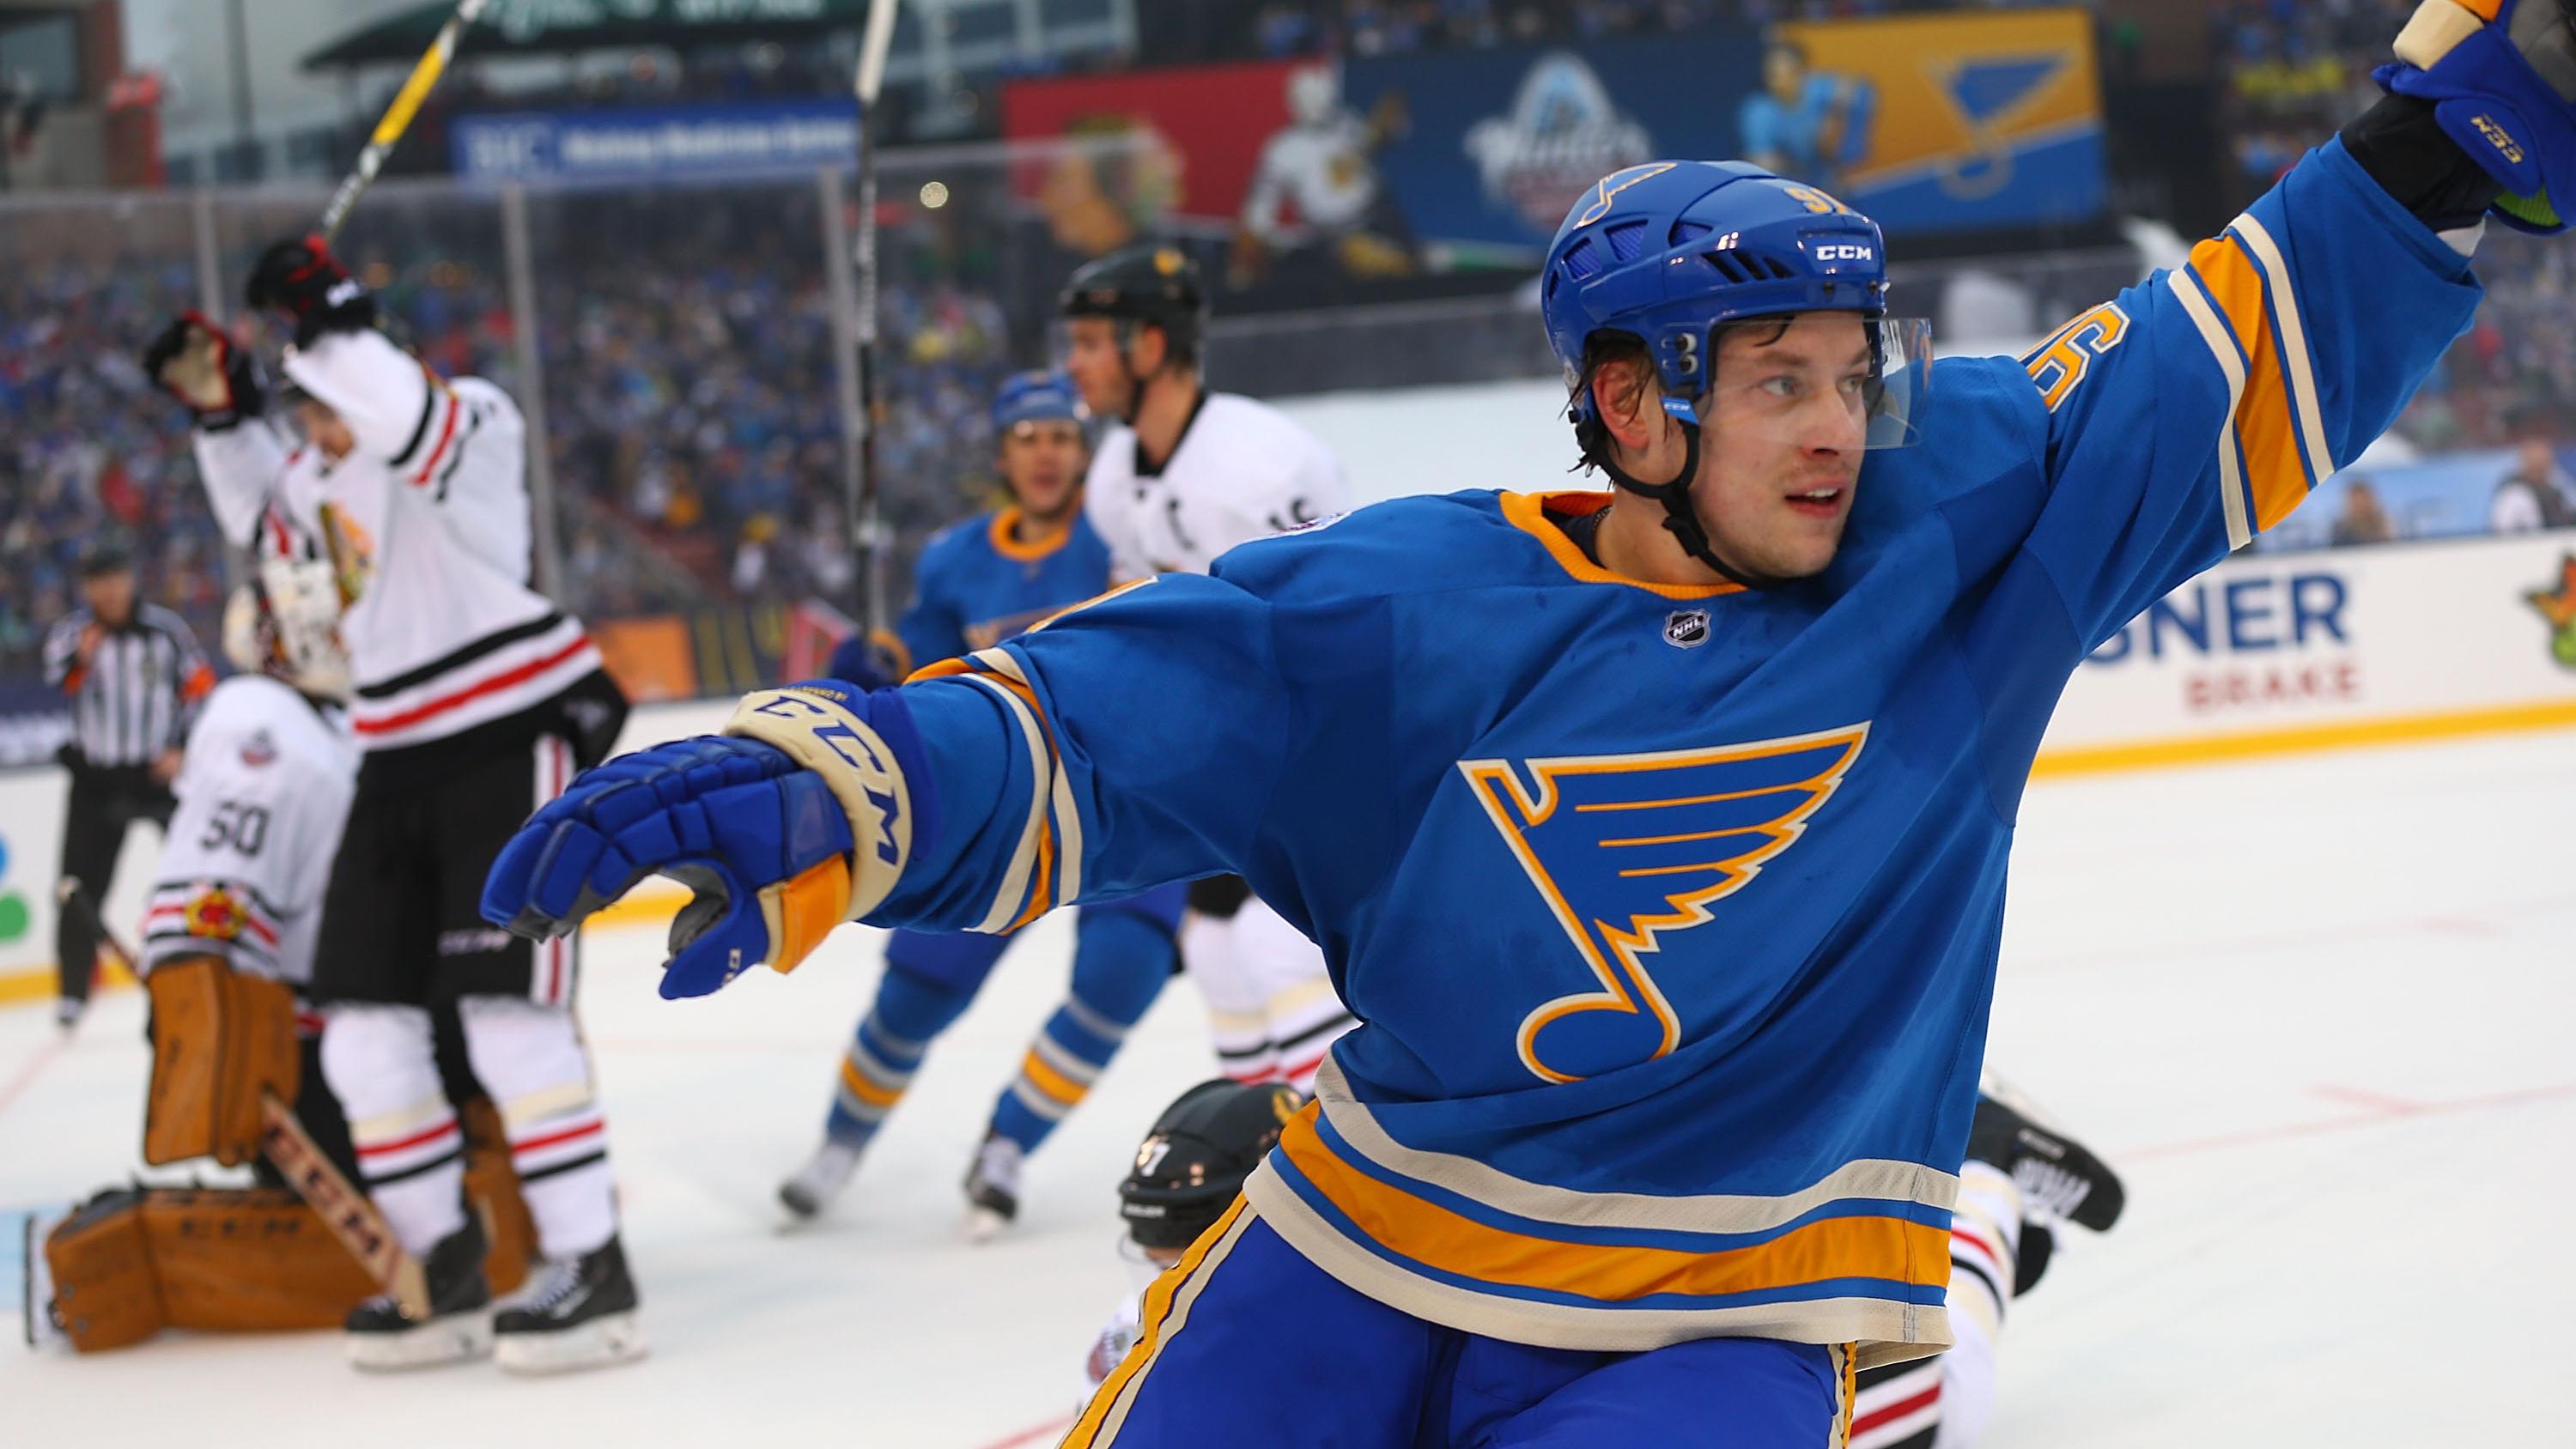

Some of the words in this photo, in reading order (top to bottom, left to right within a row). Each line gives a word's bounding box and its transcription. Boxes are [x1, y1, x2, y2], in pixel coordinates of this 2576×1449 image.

[2470, 115, 2523, 164] CCM
[1816, 245, 1873, 261] CCM
[1673, 616, 1703, 639] NHL
[2185, 660, 2363, 711] BRAKE
[754, 696, 900, 866] CCM
[200, 800, 270, 858] 50
